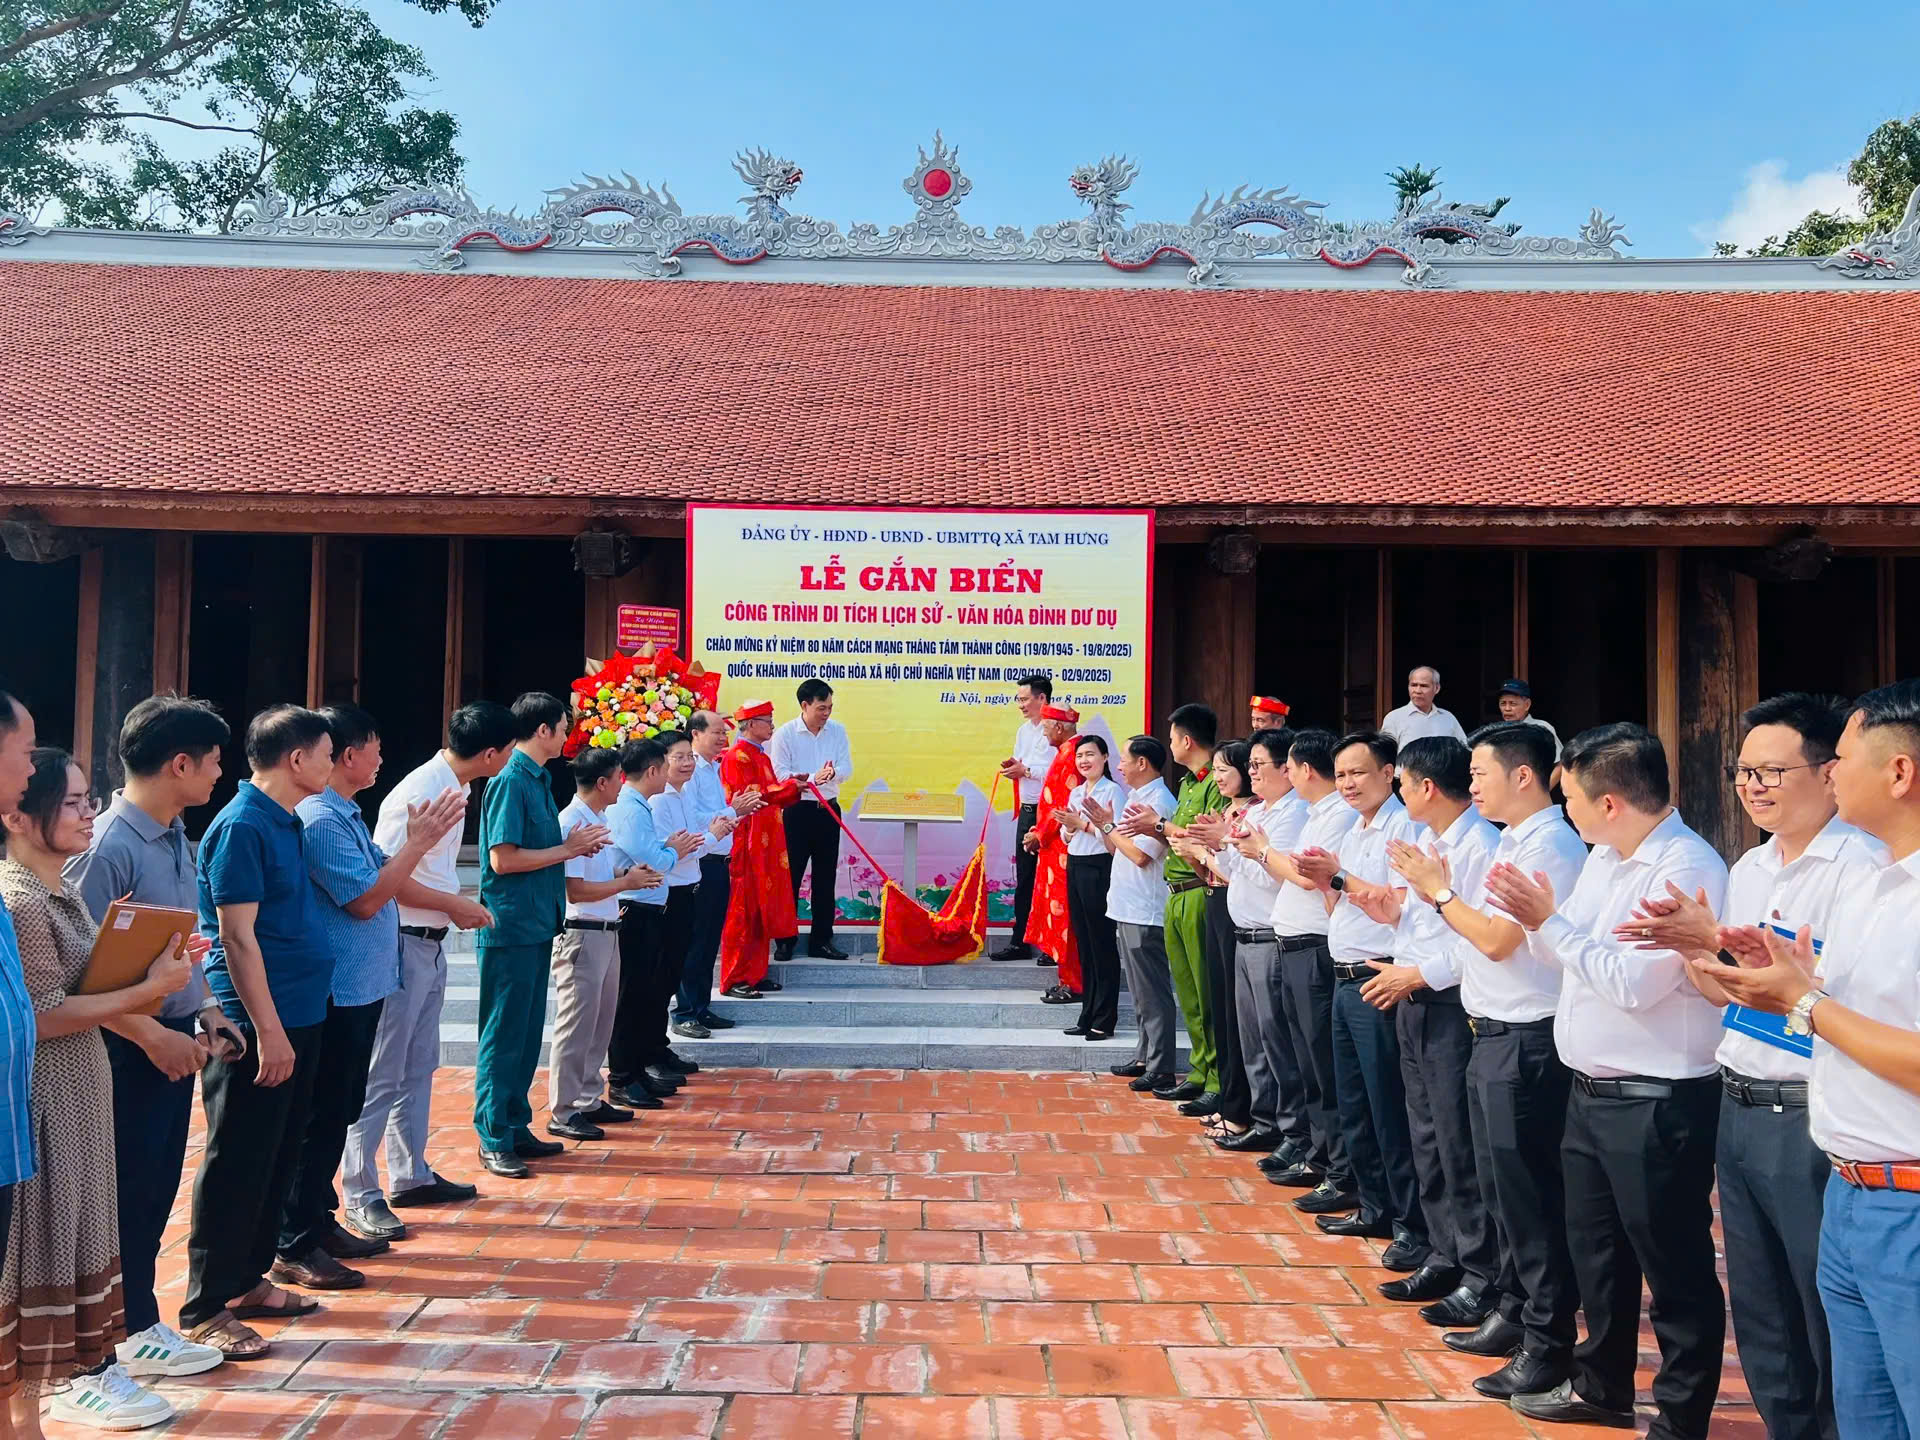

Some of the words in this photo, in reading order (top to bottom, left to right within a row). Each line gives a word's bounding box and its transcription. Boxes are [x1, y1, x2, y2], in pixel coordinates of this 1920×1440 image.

[743, 524, 785, 541] ĐẢNG
[790, 524, 811, 541] ỦY
[823, 529, 868, 542] HĐND
[880, 530, 923, 543] UBND
[936, 531, 1001, 546] UBMTTQ
[1004, 529, 1025, 545] XÃ
[1028, 532, 1060, 545] TAM
[1064, 531, 1109, 545] HƯNG
[800, 554, 846, 591] LỄ
[858, 556, 938, 592] GẮN
[949, 558, 1043, 593] BIỂN
[724, 600, 768, 622] CÔNG
[772, 601, 818, 623] TRÌNH
[823, 606, 839, 623] DI
[843, 602, 878, 624] TÍCH
[882, 607, 917, 627] LỊCH
[921, 602, 943, 625] SỬ
[957, 604, 989, 625] VĂN
[993, 604, 1024, 625] HÓA
[1028, 605, 1067, 626] ĐÌNH
[1071, 608, 1094, 626] DƯ
[1096, 609, 1118, 630] DỤ
[706, 636, 732, 652] CHÀO
[734, 636, 763, 652] MỪNG
[765, 635, 778, 652] KỶ
[780, 637, 806, 655] NIỆM
[808, 639, 820, 653] 80
[822, 638, 844, 653] NĂM
[846, 637, 872, 654] CÁCH
[874, 641, 903, 656] MẠNG
[905, 638, 937, 655] THÁNG
[939, 638, 959, 655] TÁM
[961, 640, 993, 656] THÀNH
[995, 640, 1021, 656] CÔNG
[1023, 642, 1074, 657] (19/8/1945
[1082, 643, 1132, 657] 19/8/2025)
[727, 659, 753, 678] QUỐC
[755, 661, 788, 678] KHÁNH
[790, 660, 817, 679] NƯỚC
[819, 663, 846, 682] CỘNG
[848, 662, 867, 679] HÒA
[869, 663, 883, 680] XÃ
[885, 663, 901, 682] HỘI
[903, 663, 923, 680] CHỦ
[924, 664, 954, 681] NGHĨA
[956, 664, 977, 683] VIỆT
[978, 667, 1001, 681] NAM
[1061, 668, 1112, 683] 02/9/2025)
[940, 692, 956, 703] Hà
[959, 692, 982, 706] Nội,
[984, 693, 1012, 705] ngày
[1064, 694, 1072, 705] 8
[1075, 696, 1099, 704] năm
[1101, 694, 1127, 705] 2025
